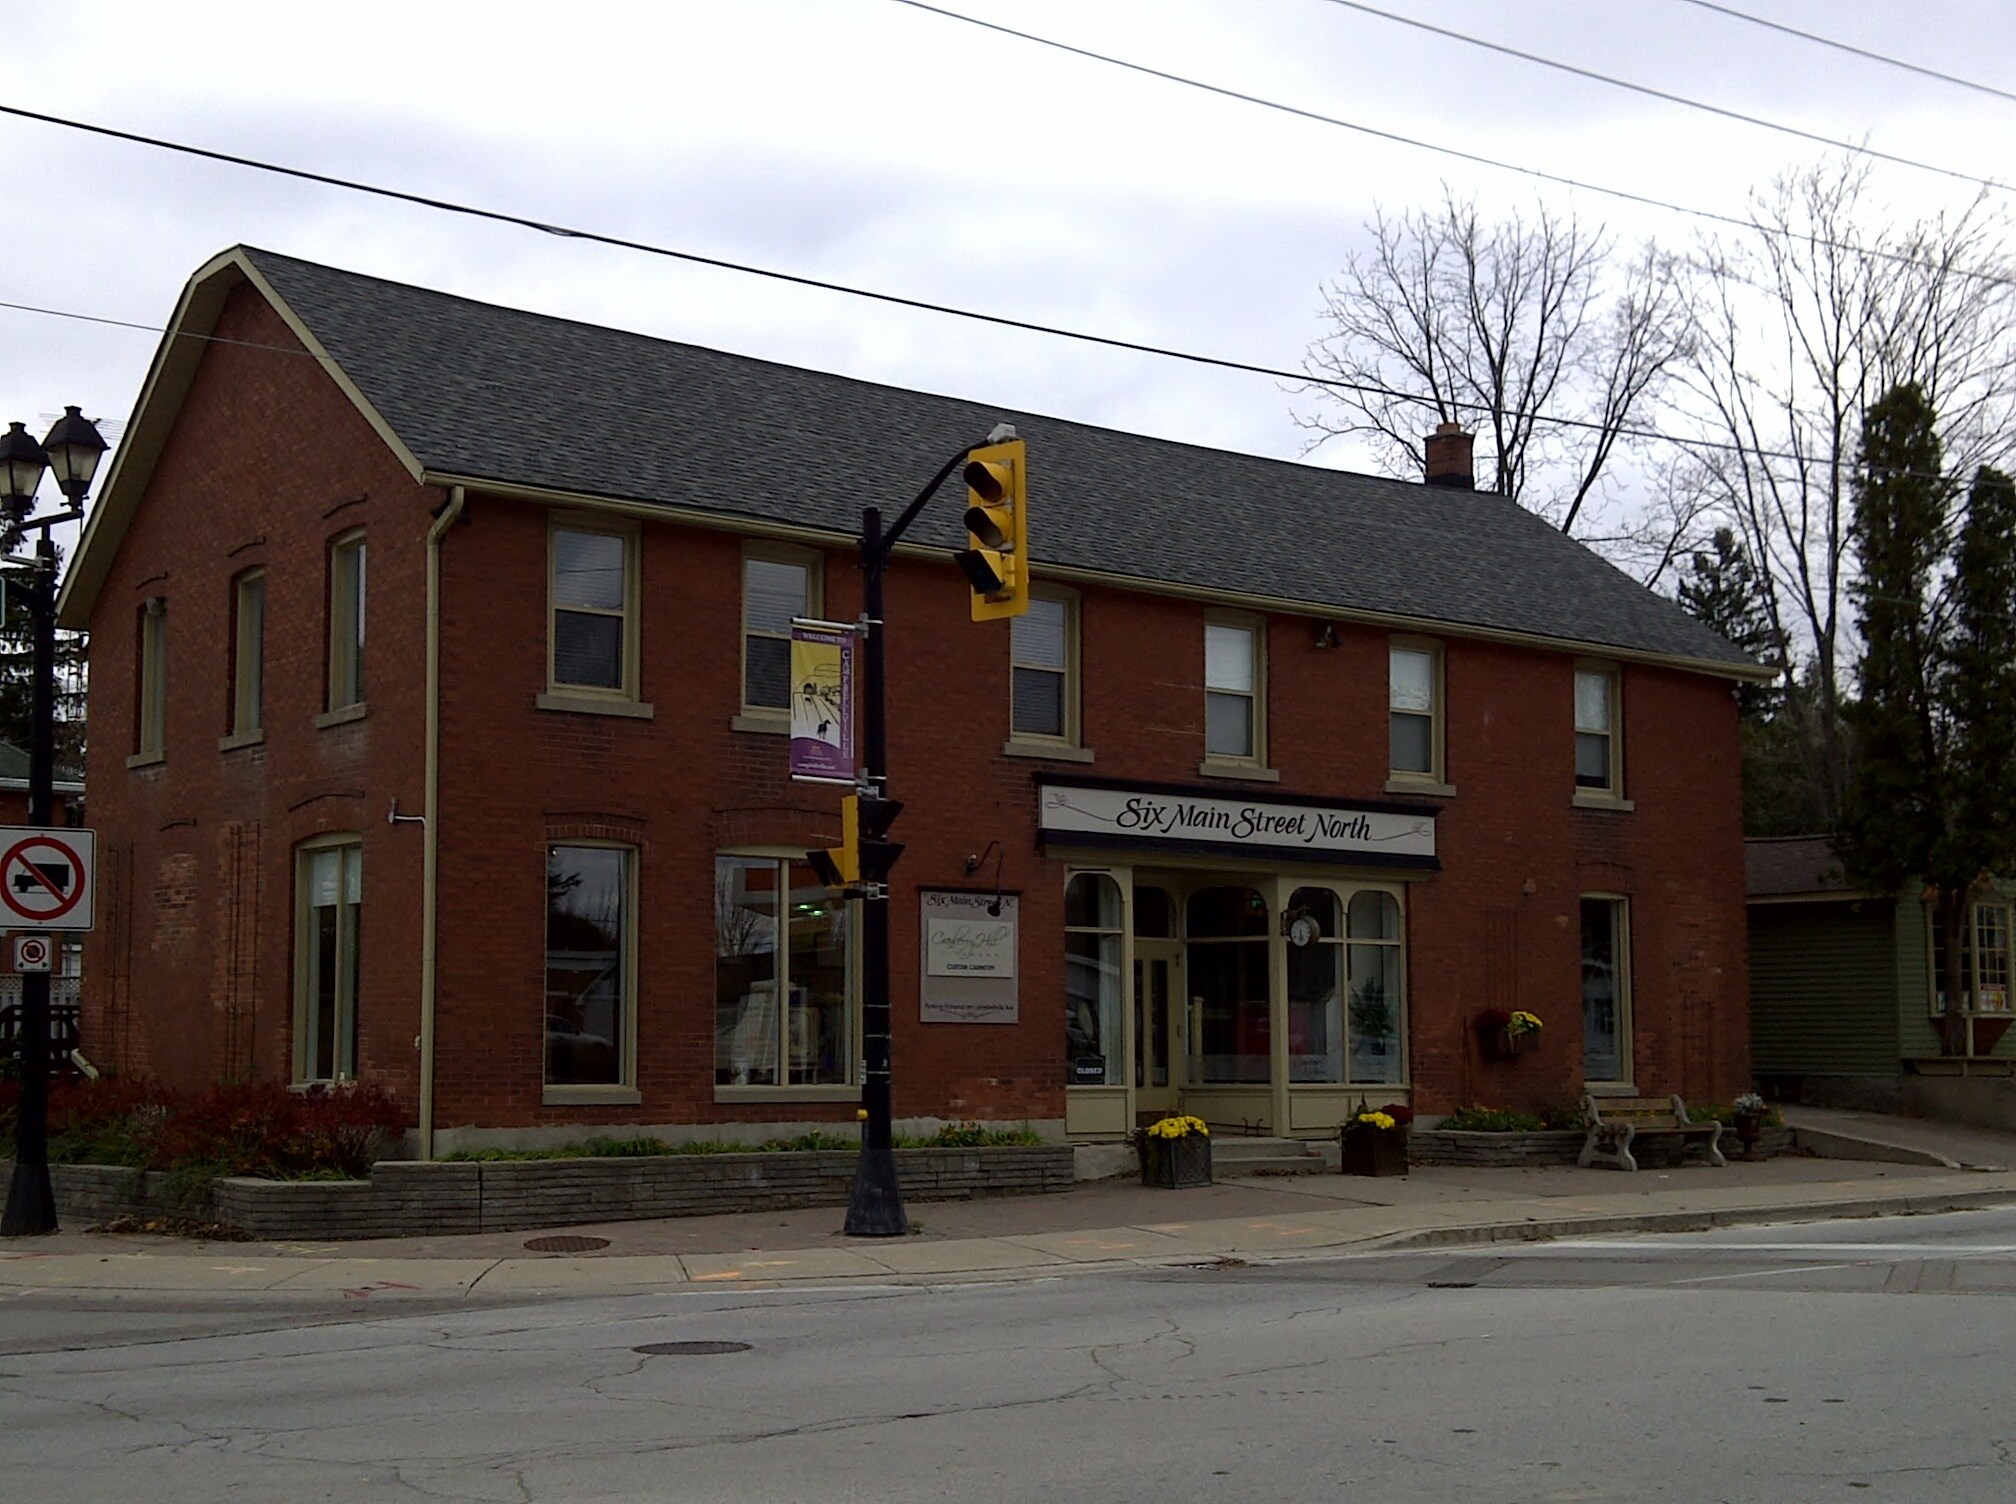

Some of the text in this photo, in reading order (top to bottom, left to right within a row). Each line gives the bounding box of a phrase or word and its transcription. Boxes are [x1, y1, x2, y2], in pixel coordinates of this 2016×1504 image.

[1116, 798, 1372, 843] Six Main Street North
[927, 894, 946, 907] Six
[945, 896, 971, 907] Main
